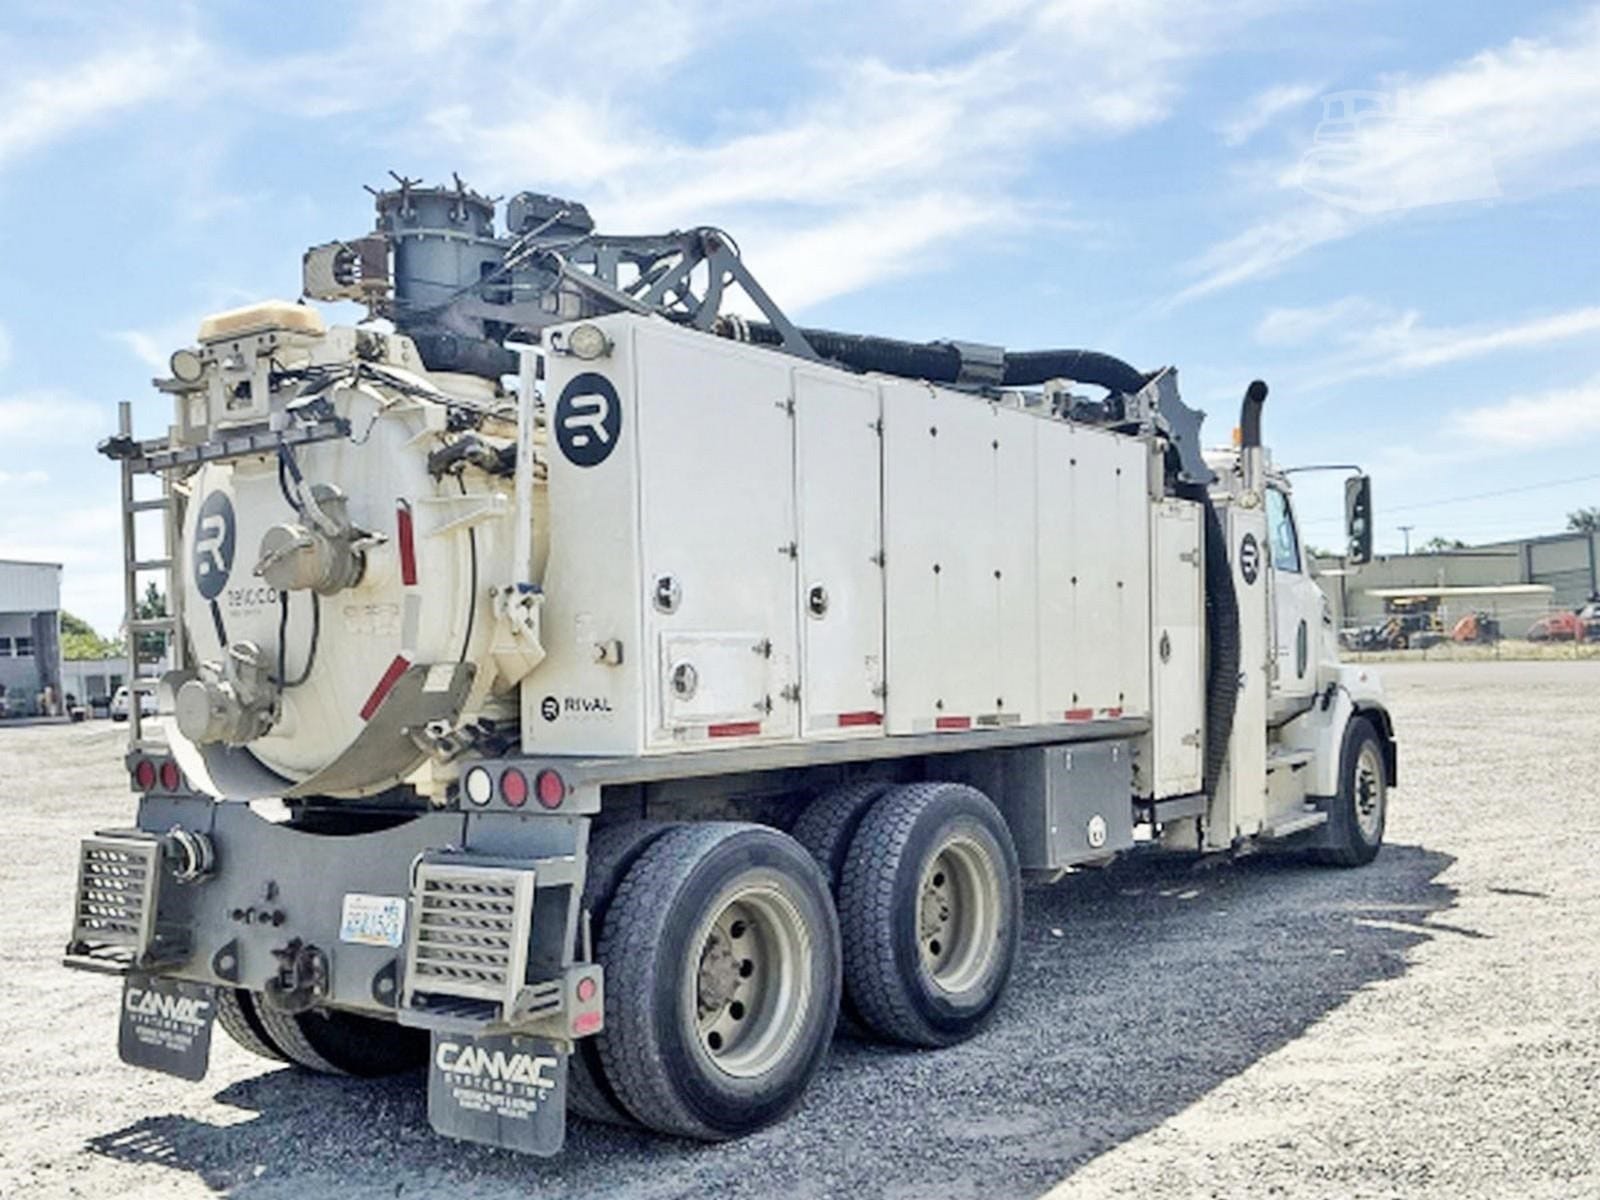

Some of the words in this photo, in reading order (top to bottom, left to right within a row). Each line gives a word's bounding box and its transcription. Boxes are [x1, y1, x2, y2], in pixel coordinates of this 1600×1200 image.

[564, 697, 612, 711] RIVAL
[126, 987, 210, 1027] CANVAC
[436, 1042, 558, 1089] CANVAC
